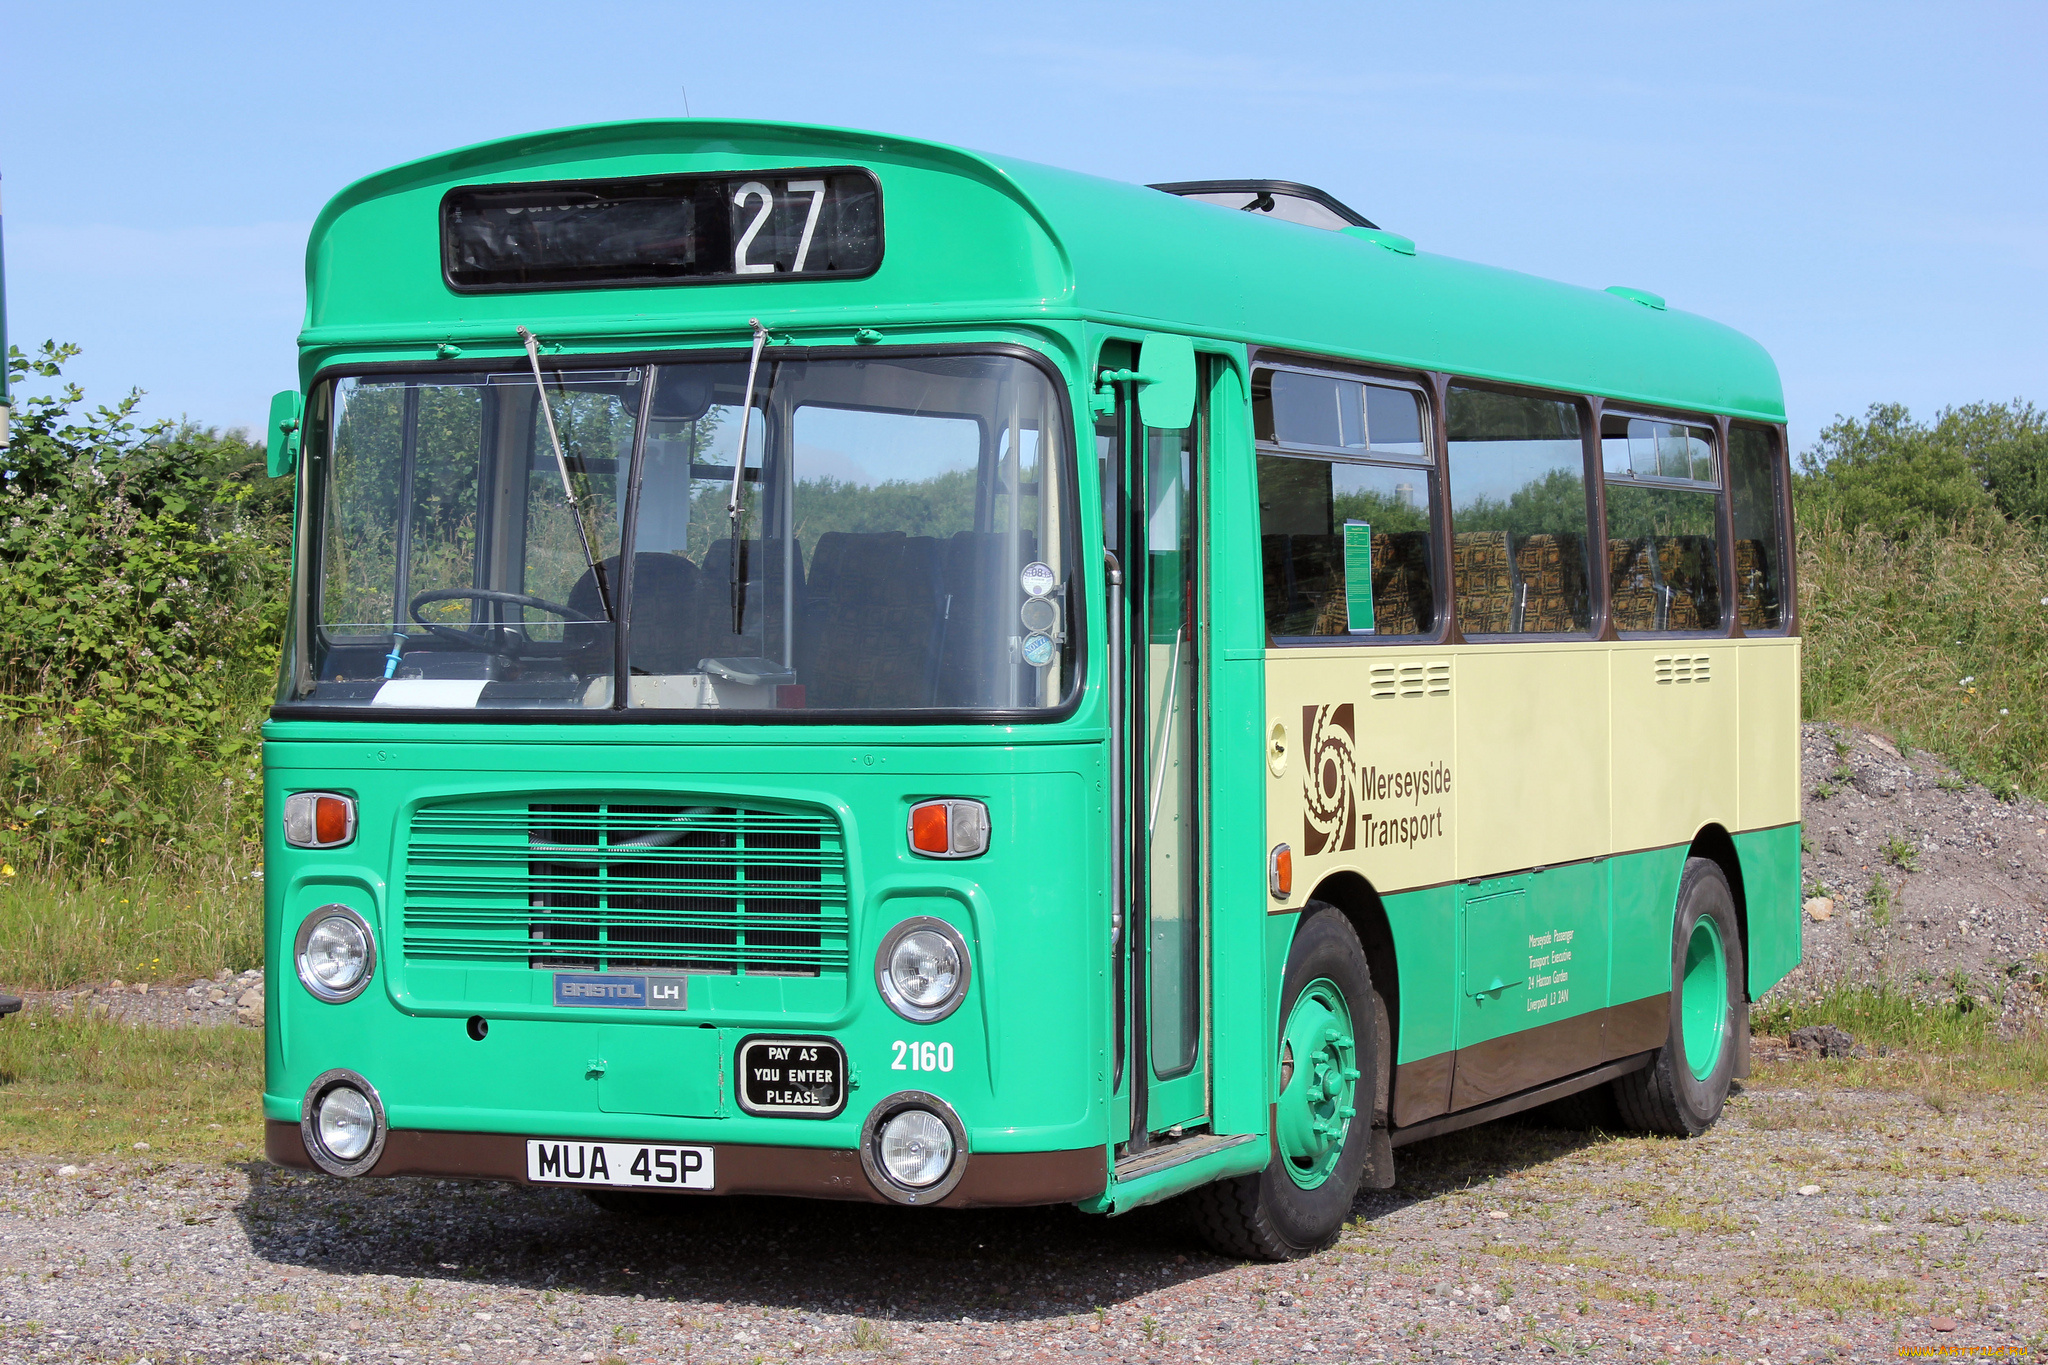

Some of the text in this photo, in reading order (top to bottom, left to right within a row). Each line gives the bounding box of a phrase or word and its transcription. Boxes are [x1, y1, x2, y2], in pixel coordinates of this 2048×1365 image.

[733, 180, 826, 275] 27
[1361, 760, 1451, 806] Merseyside
[1362, 807, 1443, 849] Transport
[1528, 929, 1574, 949] Merseyside Passenger
[1528, 948, 1572, 970] Transport Executive
[562, 983, 679, 999] BRISTOL LH
[1528, 969, 1569, 990] 24 Hatton Garden
[1527, 989, 1569, 1013] Liverpool L3 2AN
[768, 1047, 818, 1062] PAY AS
[891, 1041, 954, 1073] 2160
[754, 1068, 833, 1083] YOU ENTER
[538, 1144, 704, 1185] MUA 45P
